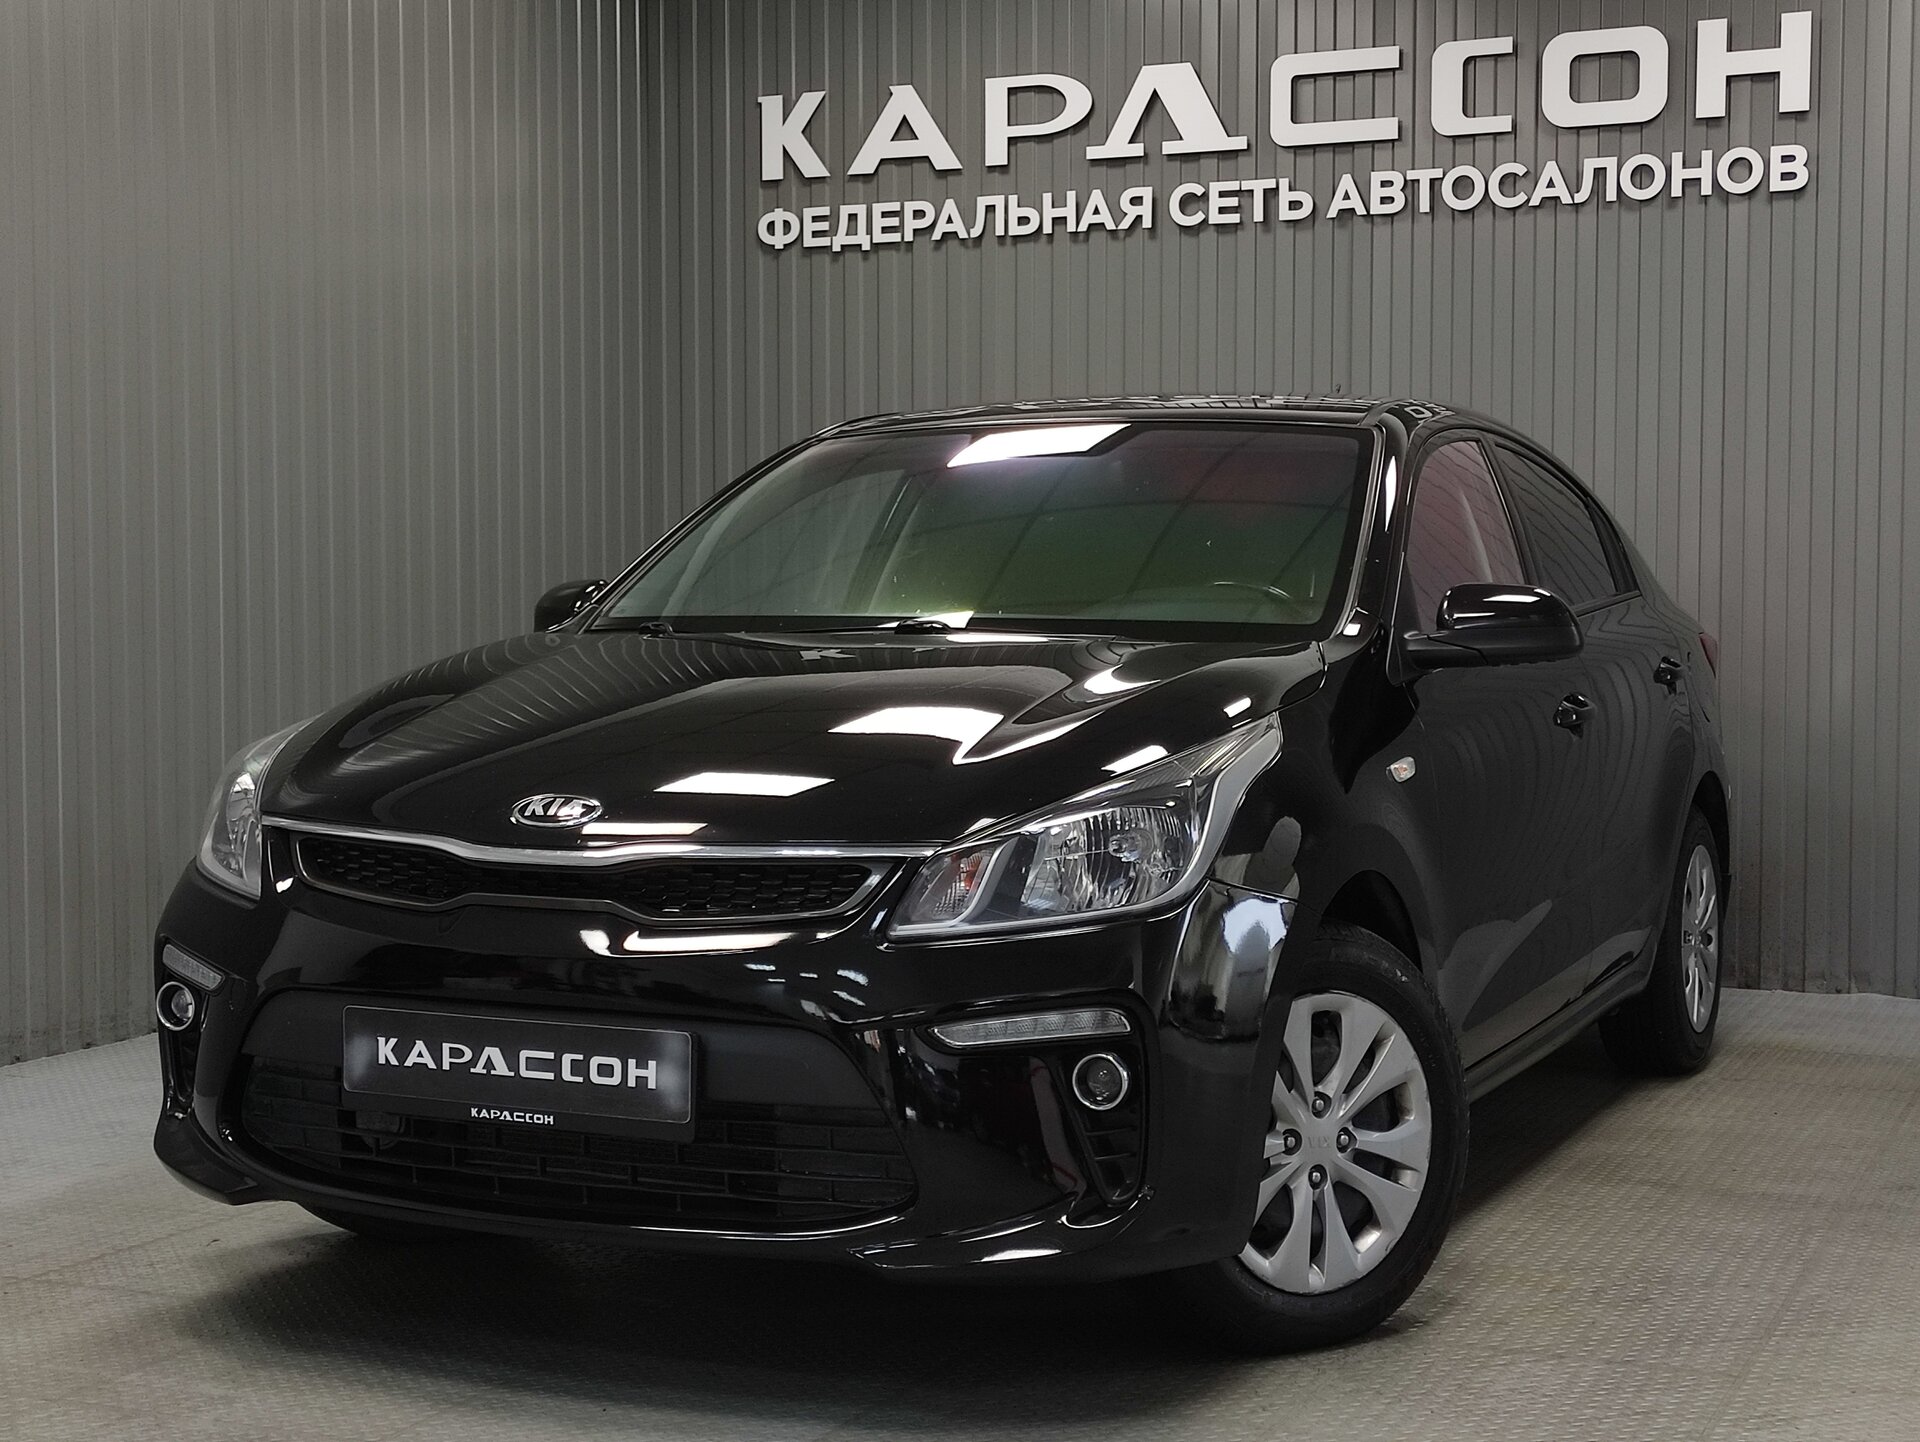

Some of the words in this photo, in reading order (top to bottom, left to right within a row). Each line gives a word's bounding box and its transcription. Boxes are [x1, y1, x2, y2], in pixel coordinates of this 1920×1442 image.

[757, 186, 1153, 252] ФЕДЕРАЛЬНАЯ
[1168, 177, 1314, 227] СЕТЬ
[1327, 144, 1809, 219] АВТОСАЛОНОВ
[523, 798, 588, 818] KIA
